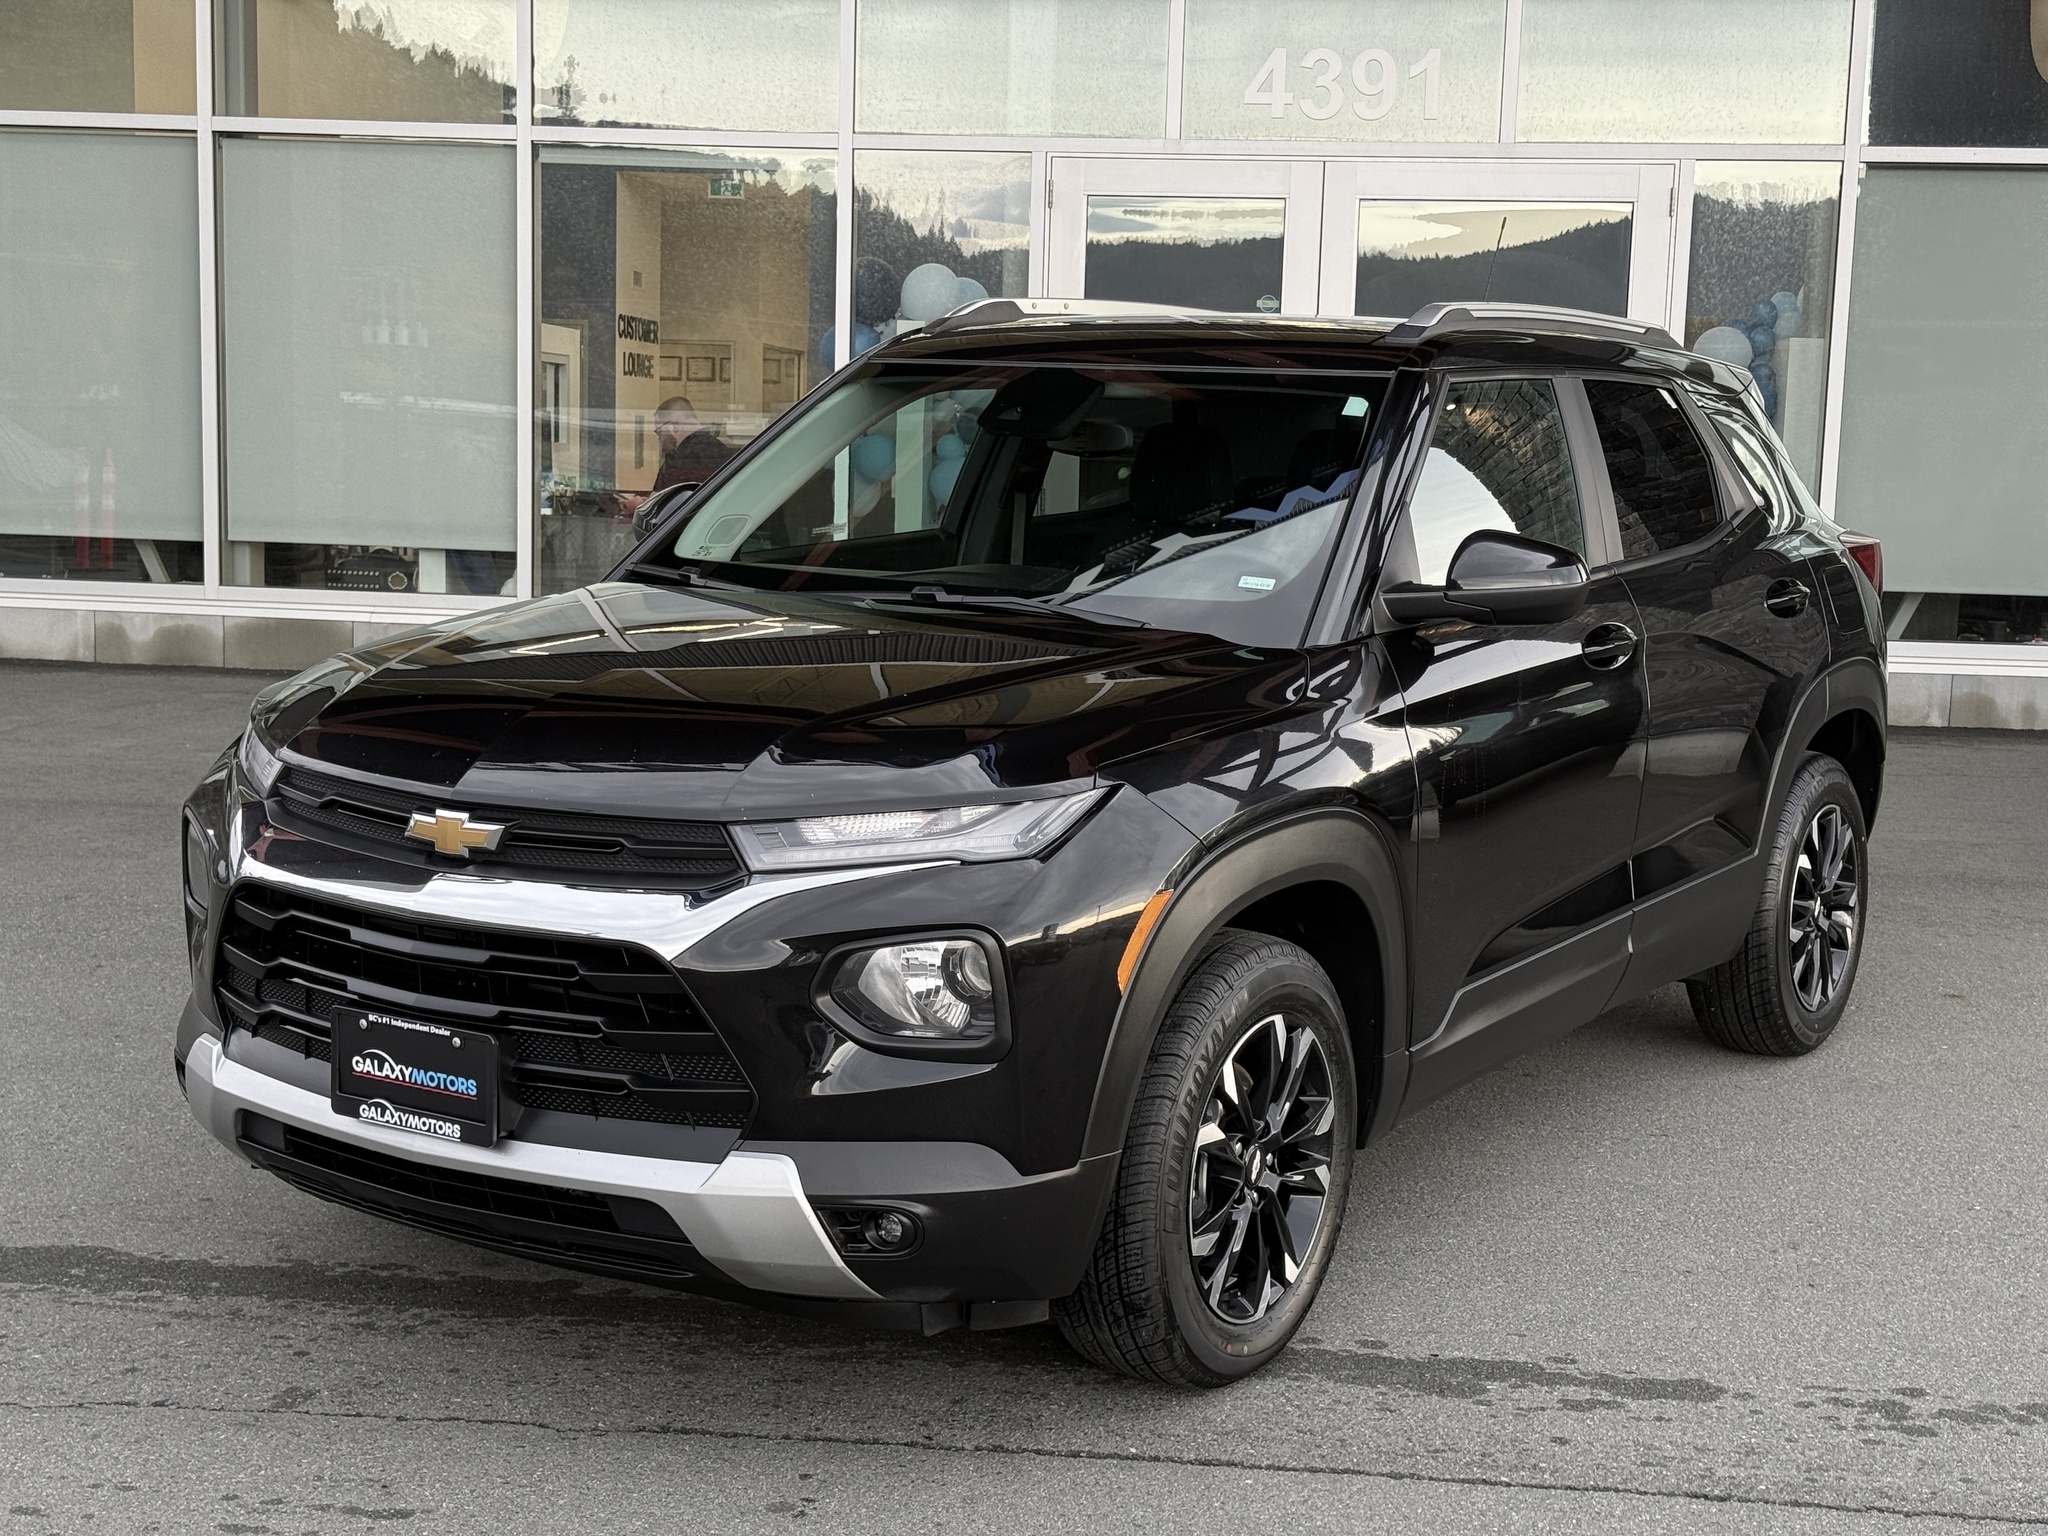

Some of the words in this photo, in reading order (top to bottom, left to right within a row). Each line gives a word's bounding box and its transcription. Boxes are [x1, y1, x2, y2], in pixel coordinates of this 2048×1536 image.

[1243, 47, 1442, 121] 4391
[617, 313, 659, 345] CUSTOMER
[622, 351, 654, 379] LOUNGE
[368, 1013, 382, 1023] BC's
[391, 1018, 430, 1032] Independent
[430, 1026, 451, 1036] Dealer
